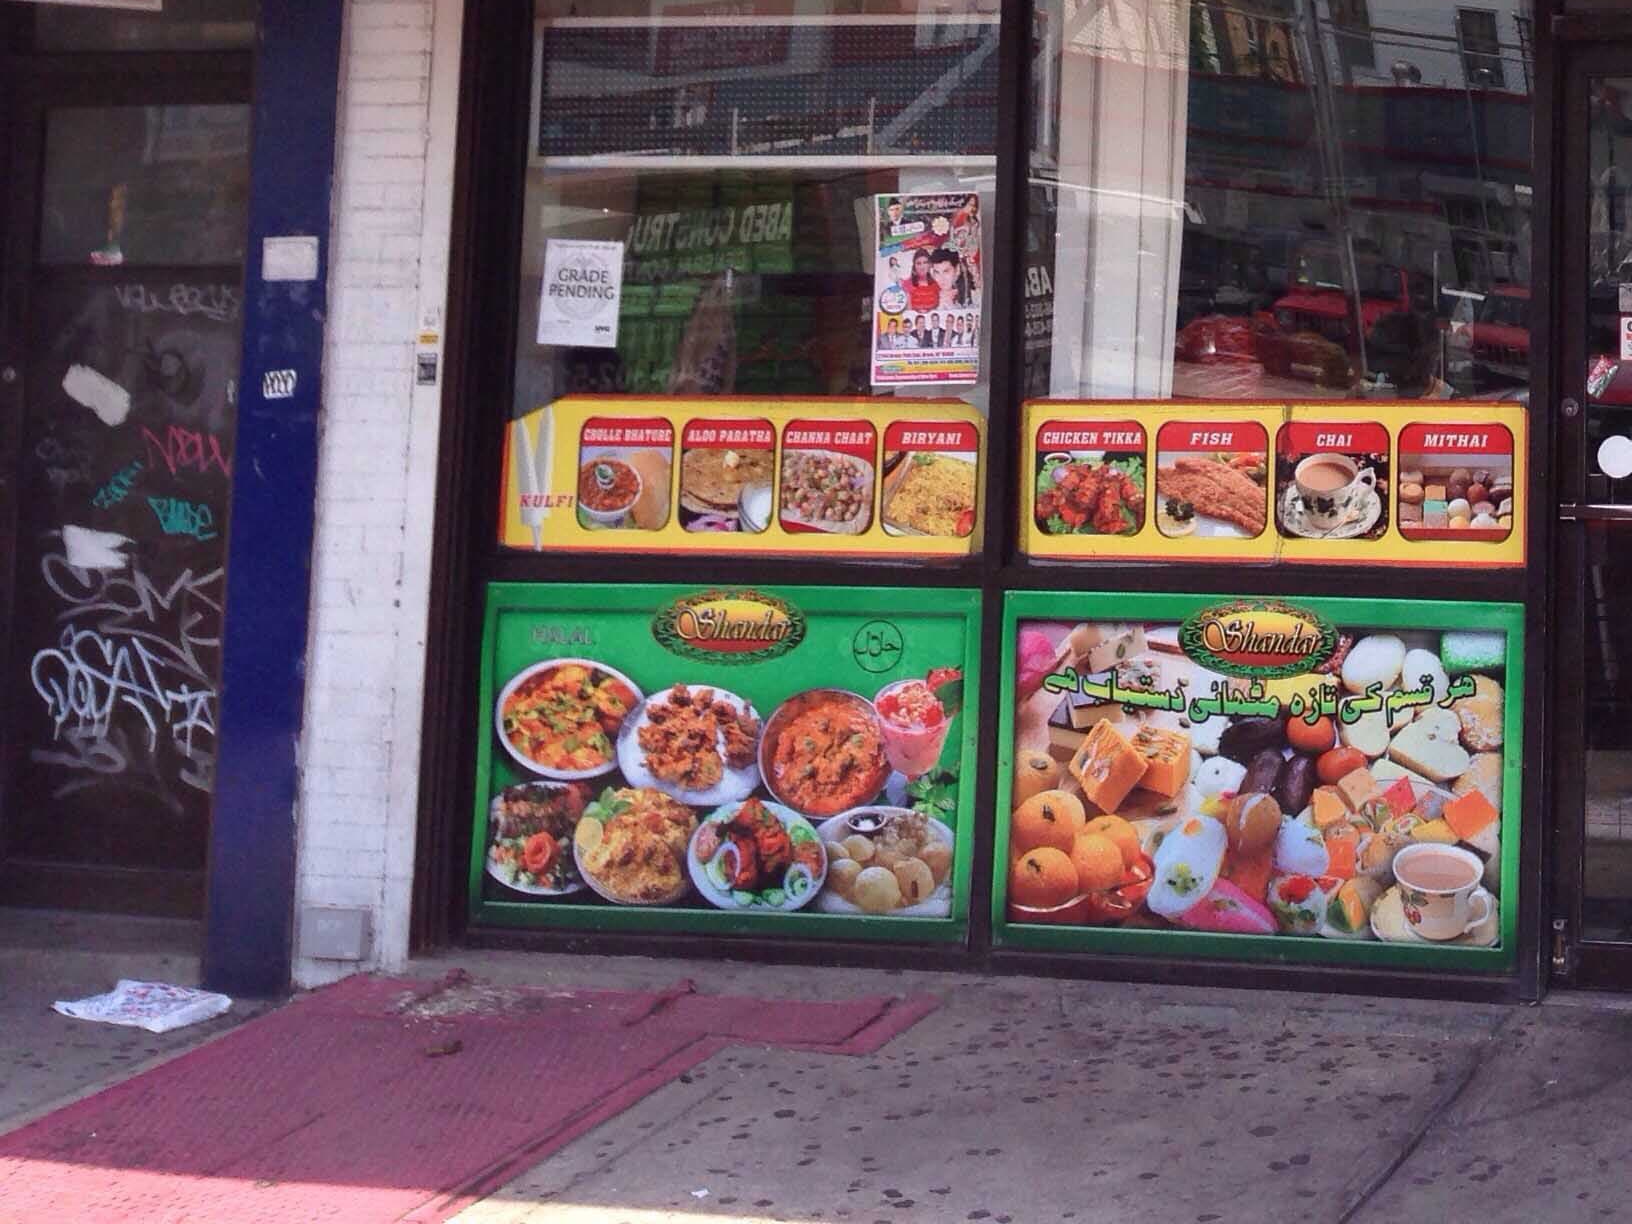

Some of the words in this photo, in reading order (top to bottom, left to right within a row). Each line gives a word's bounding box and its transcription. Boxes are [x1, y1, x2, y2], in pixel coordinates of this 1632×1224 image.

[558, 268, 609, 284] GRADE
[549, 283, 615, 300] PENDING
[687, 429, 716, 442] ALOO
[719, 429, 772, 443] PARATHA
[785, 431, 832, 444] CHANNA
[834, 431, 874, 445] CHAAT
[901, 432, 963, 445] BIRYANI
[1043, 431, 1099, 446] CHICKEN
[1102, 431, 1143, 446] TIKKA
[1190, 431, 1234, 447] FISH
[1316, 432, 1353, 447] CHAI
[1423, 432, 1489, 448] MITHAI
[518, 494, 573, 508] KULFI
[674, 604, 792, 643] Shandar
[1200, 614, 1324, 656] Shandar
